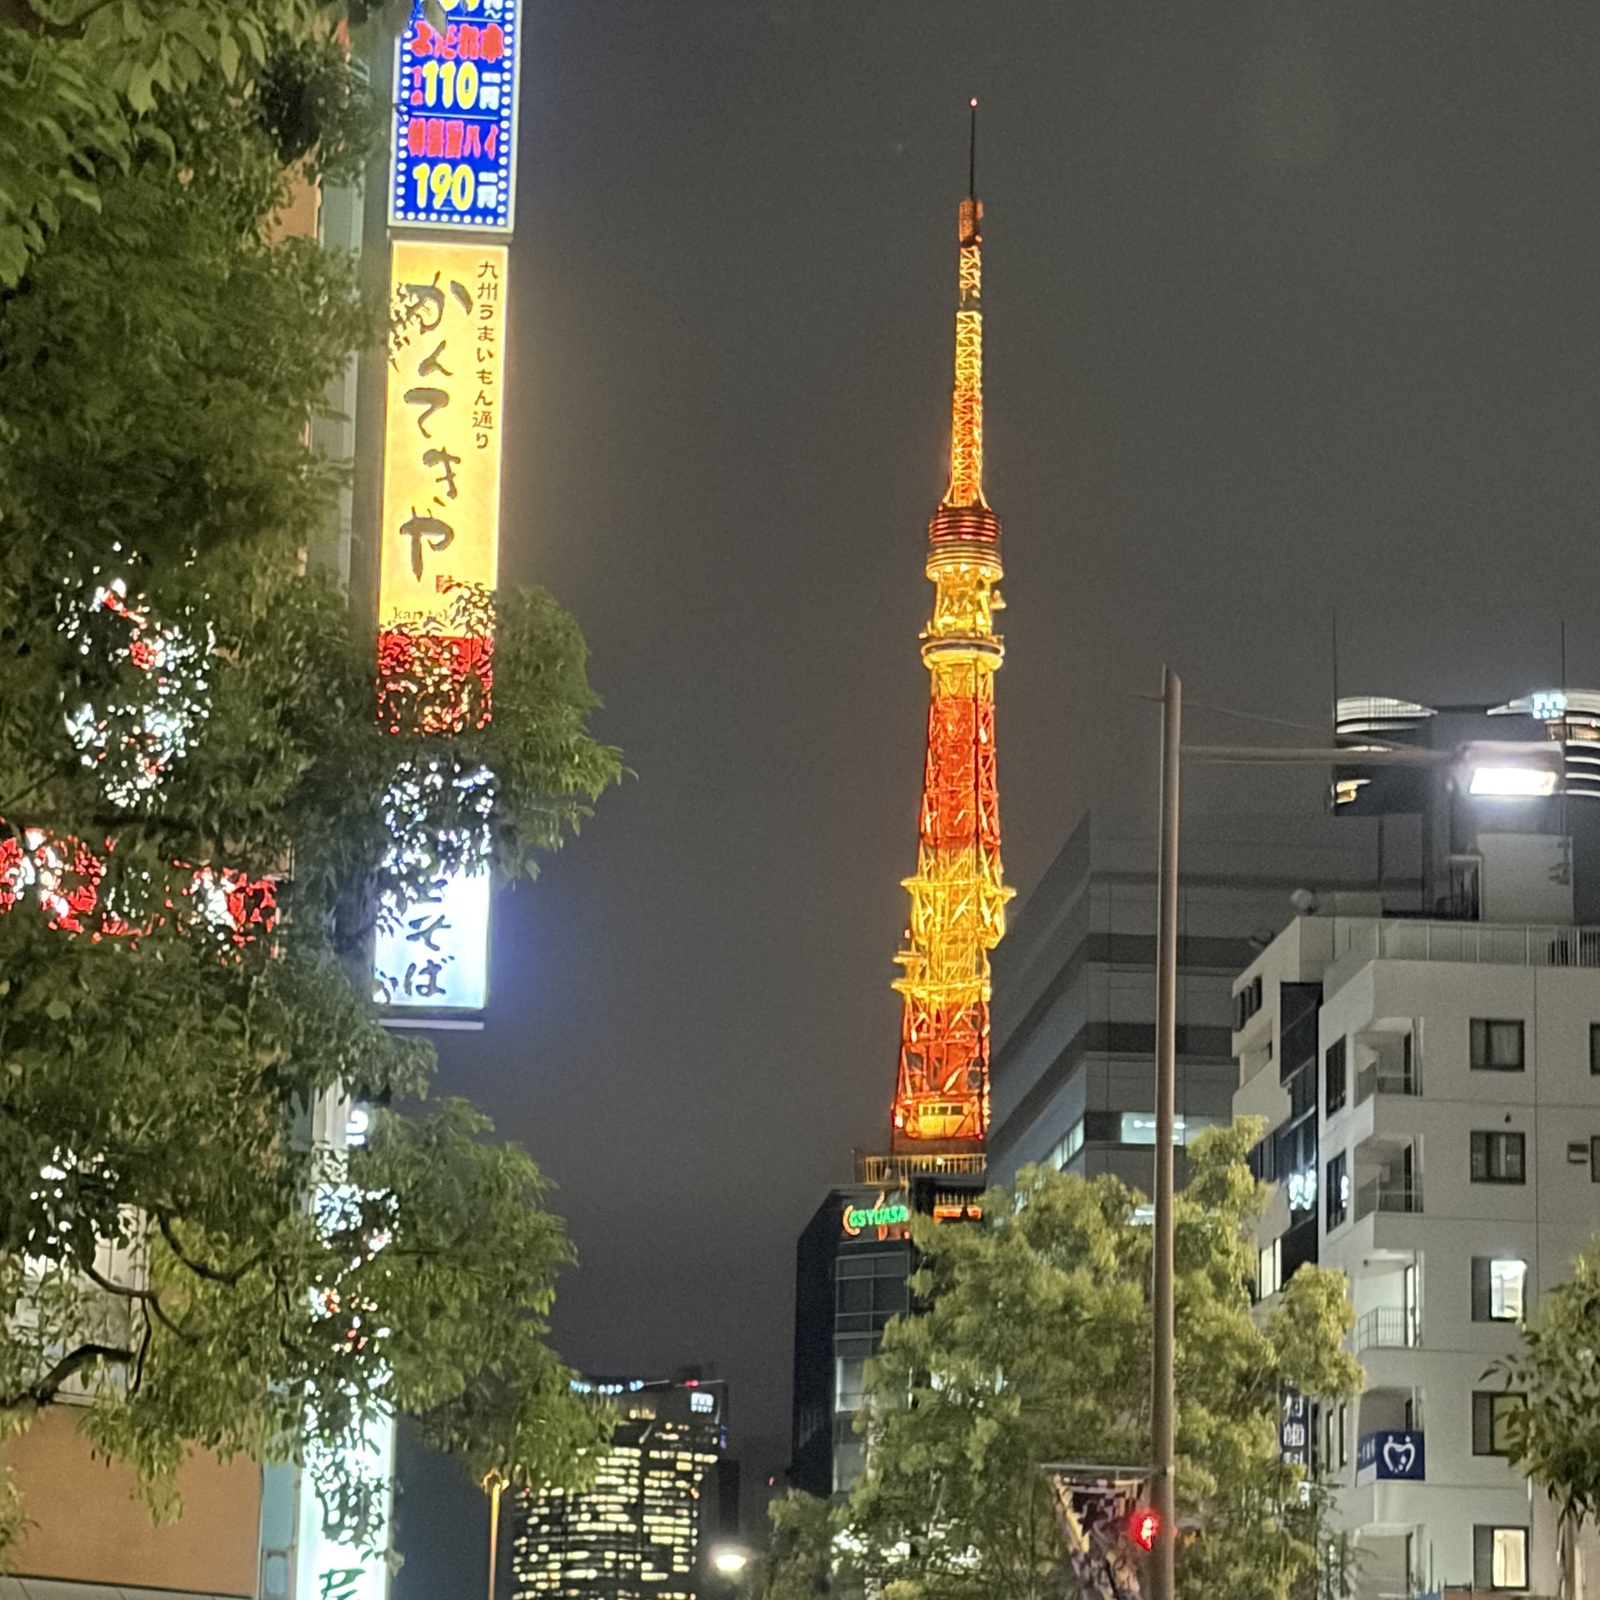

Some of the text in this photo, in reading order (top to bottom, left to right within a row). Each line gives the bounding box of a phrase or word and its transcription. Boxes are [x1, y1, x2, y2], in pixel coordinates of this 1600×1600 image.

[399, 270, 474, 583] かんてきや
[471, 261, 499, 450] 九州うまいもん通り
